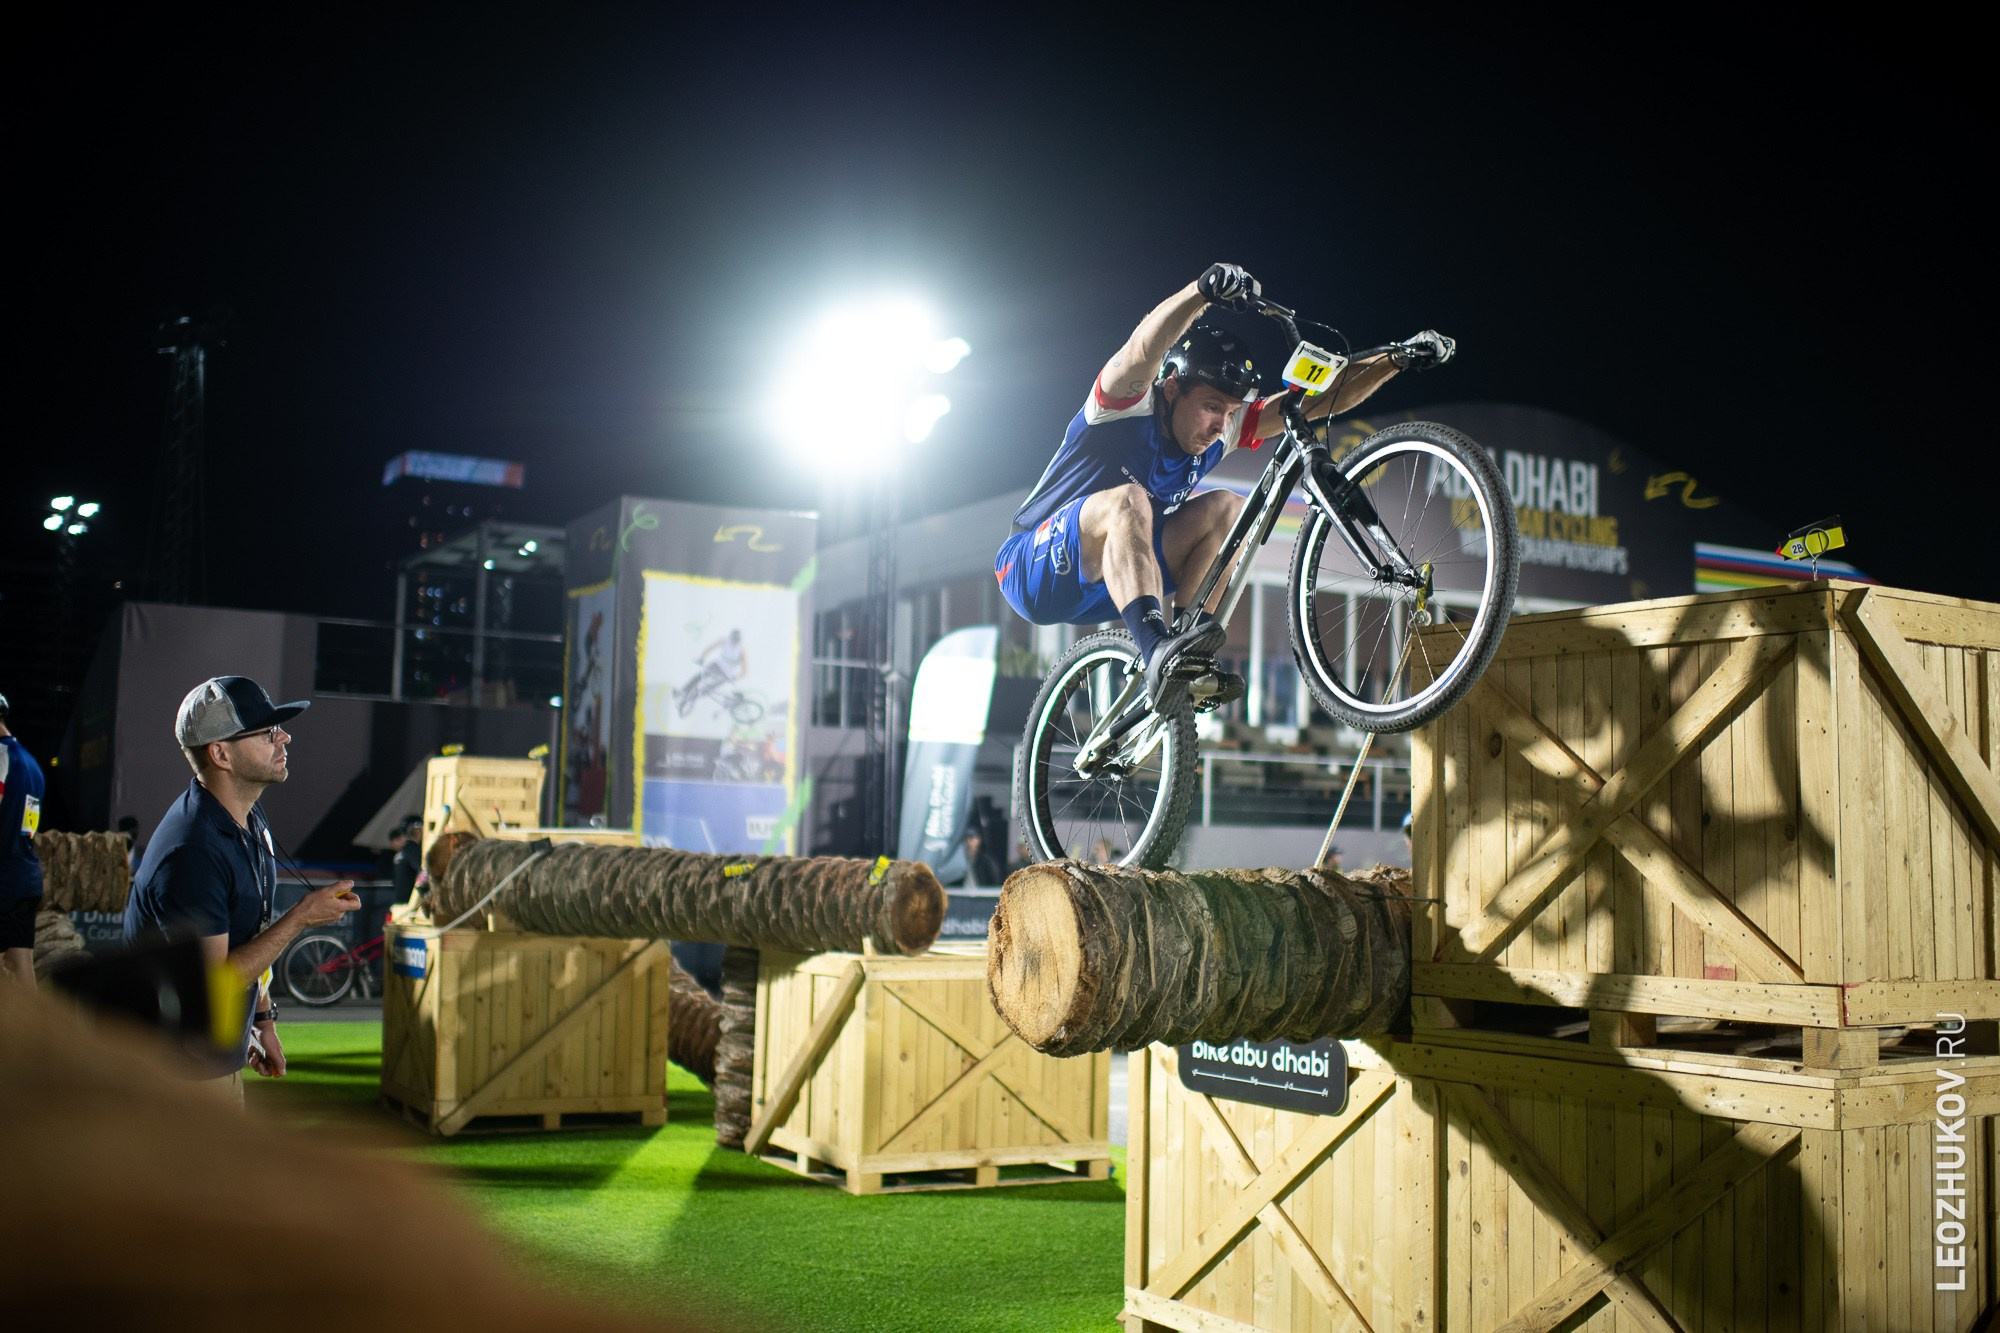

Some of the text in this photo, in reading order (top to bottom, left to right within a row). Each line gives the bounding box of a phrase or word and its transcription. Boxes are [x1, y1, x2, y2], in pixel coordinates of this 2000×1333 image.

[1306, 364, 1324, 382] 11
[1504, 450, 1598, 518] DHABI
[1231, 1041, 1268, 1069] abu
[1271, 1045, 1330, 1078] dhabi
